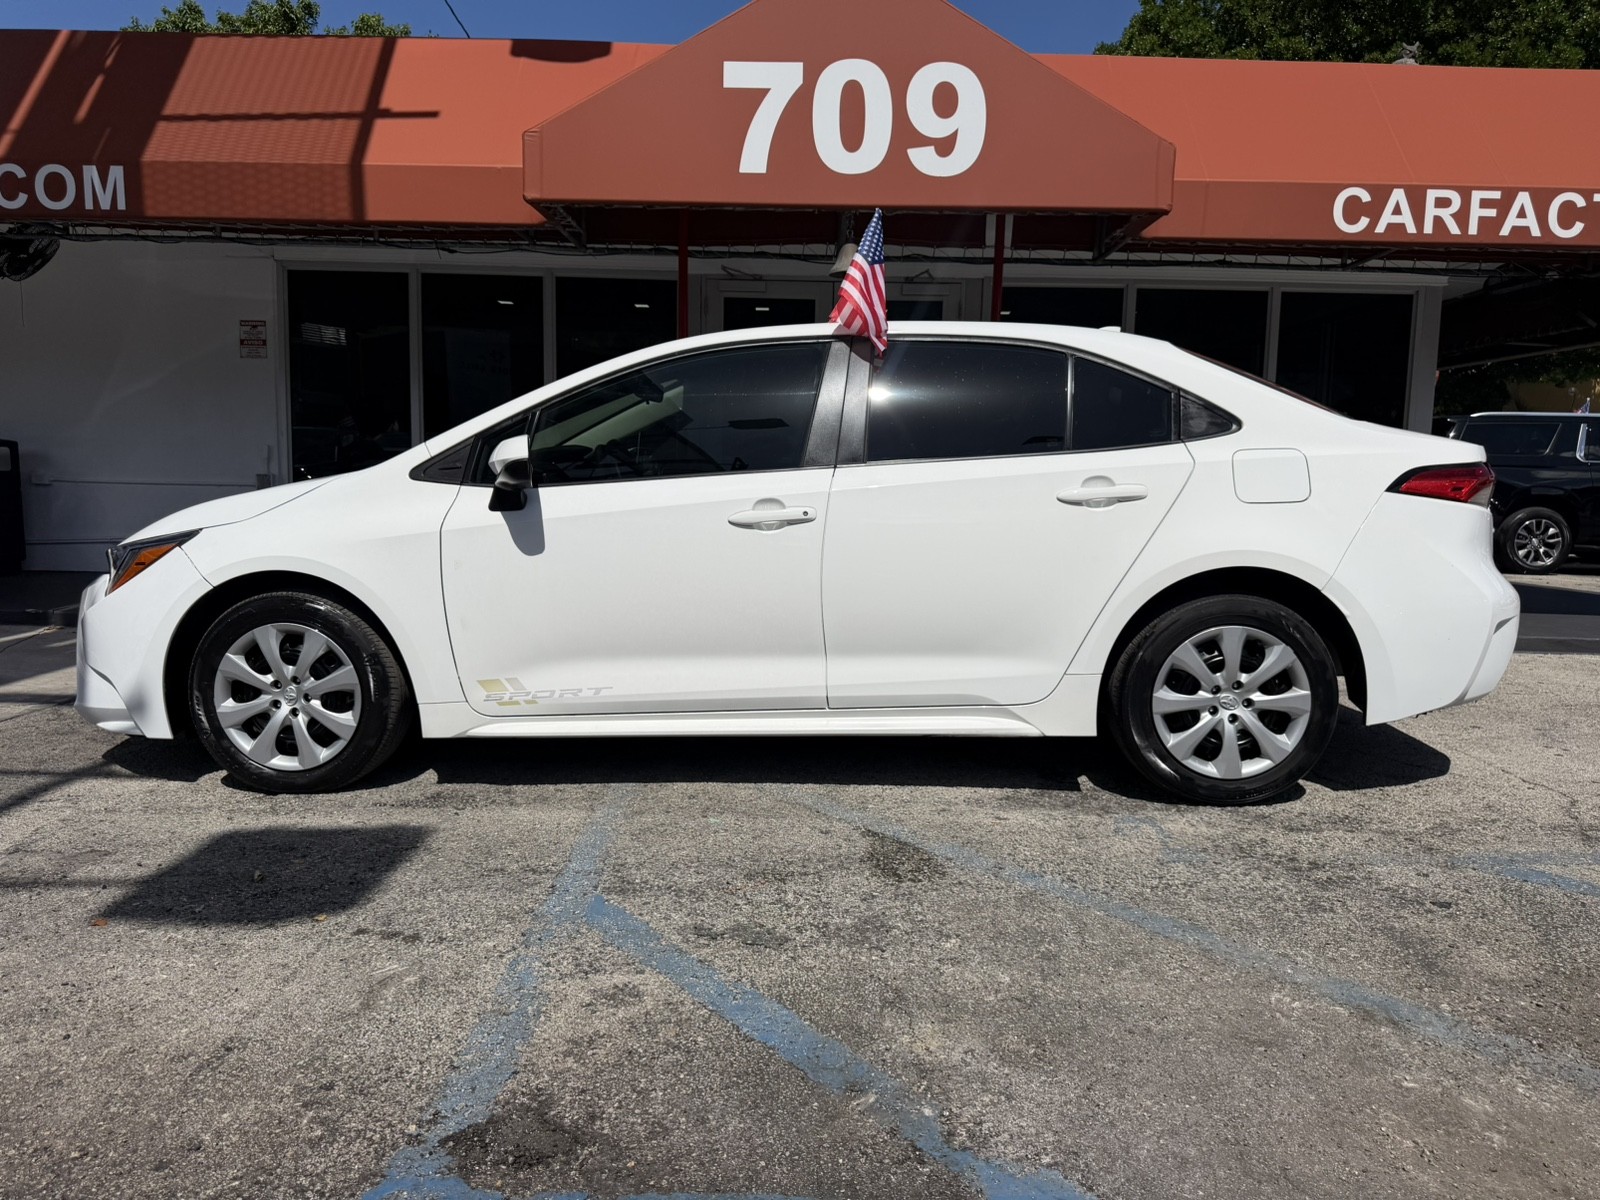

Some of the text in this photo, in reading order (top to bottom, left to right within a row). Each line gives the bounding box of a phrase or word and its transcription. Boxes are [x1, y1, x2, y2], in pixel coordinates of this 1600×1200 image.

[722, 58, 987, 177] 709
[0, 163, 127, 211] COM
[483, 686, 614, 702] SPORT
